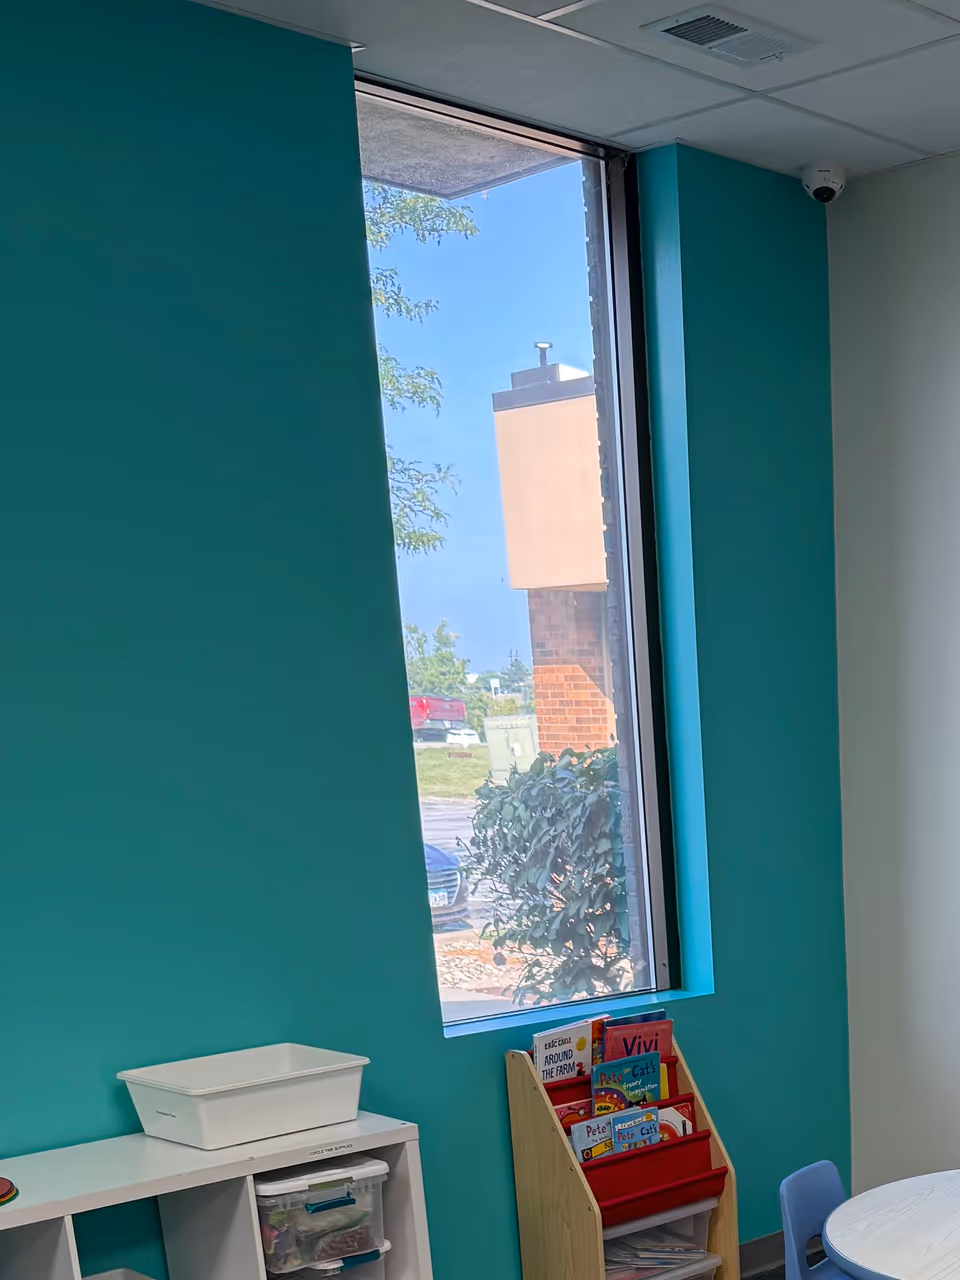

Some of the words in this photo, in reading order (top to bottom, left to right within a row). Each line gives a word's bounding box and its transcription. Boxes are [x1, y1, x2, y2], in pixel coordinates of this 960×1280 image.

[544, 1049, 574, 1067] AROUND
[541, 1067, 555, 1081] THE
[555, 1061, 576, 1077] FARM
[599, 1072, 623, 1087] Pete
[631, 1060, 657, 1078] Cat's
[585, 1124, 607, 1138] Pete
[616, 1131, 635, 1142] Pete
[640, 1123, 658, 1136] Cat's
